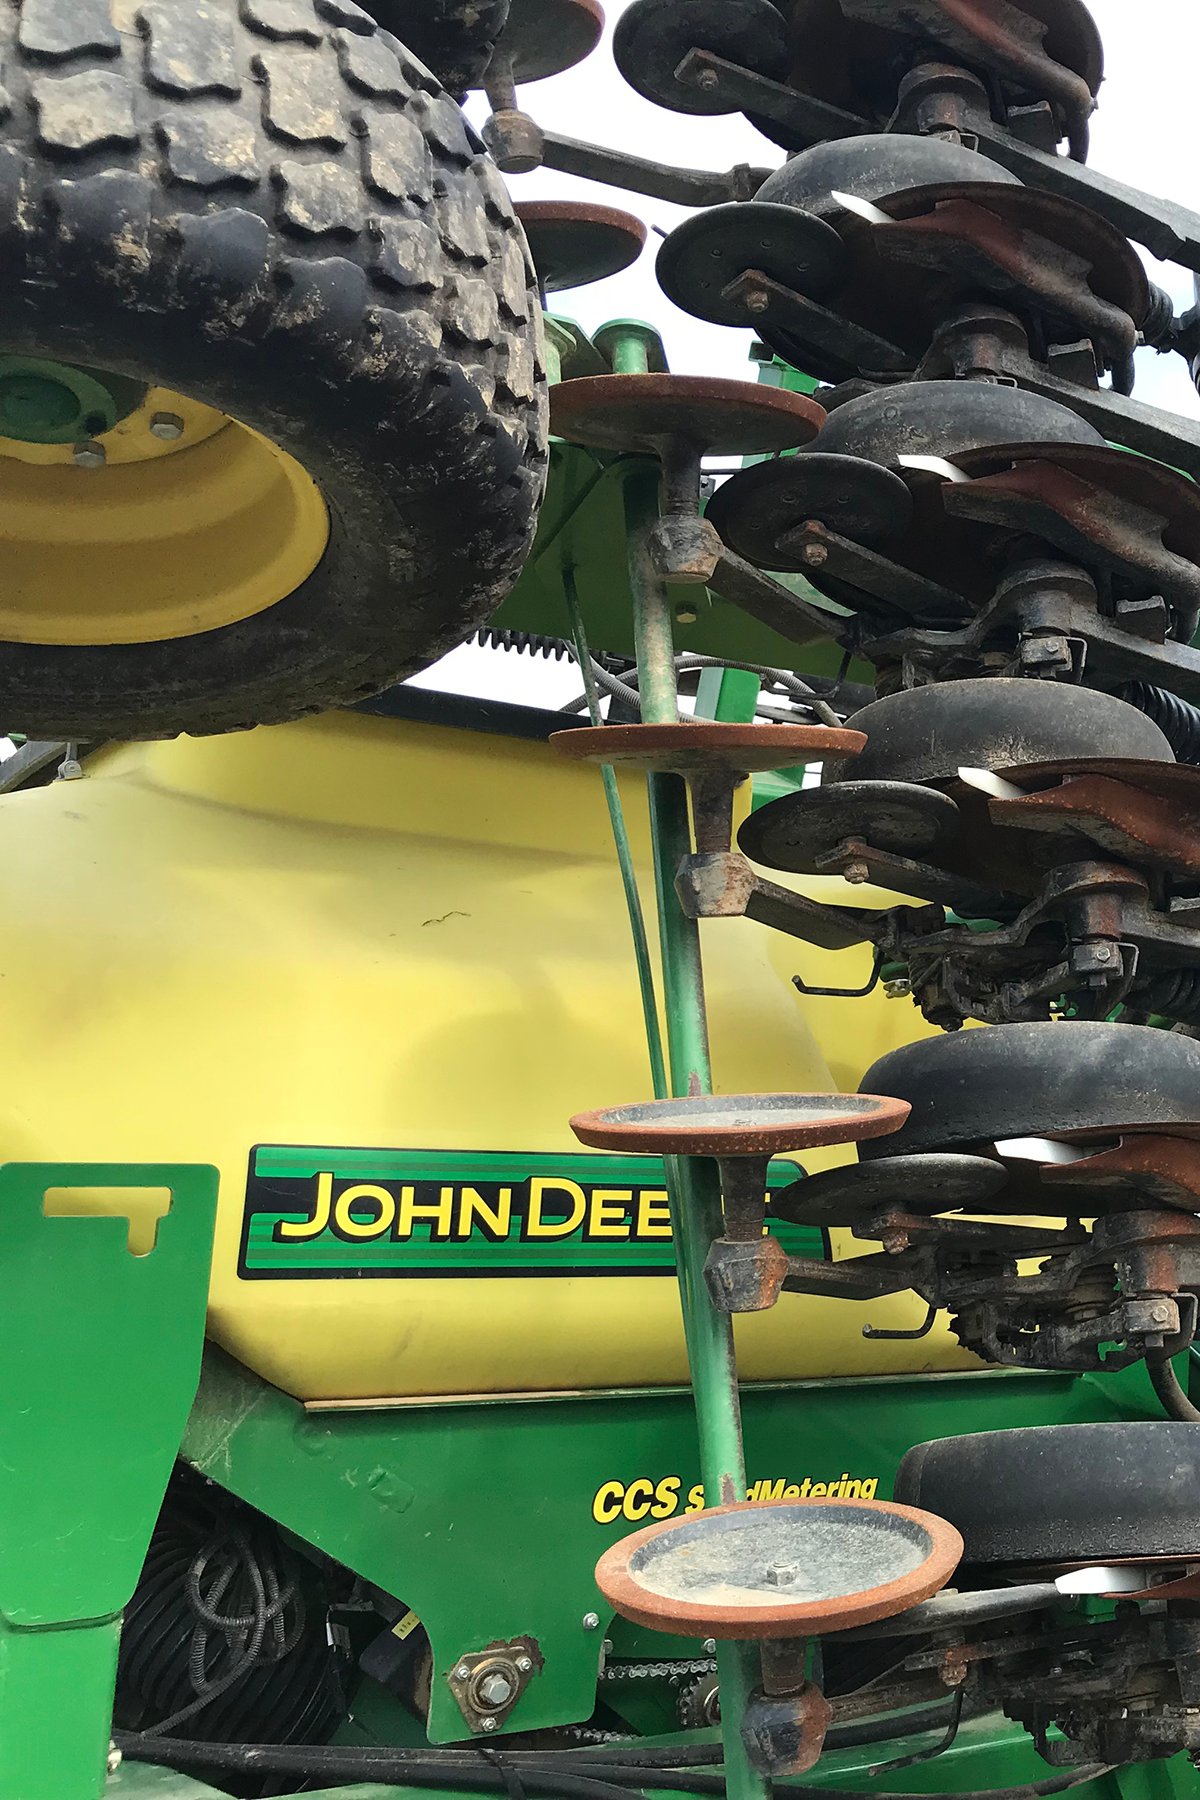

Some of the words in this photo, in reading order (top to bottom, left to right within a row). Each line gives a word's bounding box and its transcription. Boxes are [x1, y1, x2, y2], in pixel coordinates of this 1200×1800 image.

[280, 1172, 512, 1237] JOHN
[526, 1177, 770, 1236] DEE
[592, 1476, 682, 1524] CCS
[684, 1473, 879, 1512] sdMetering
